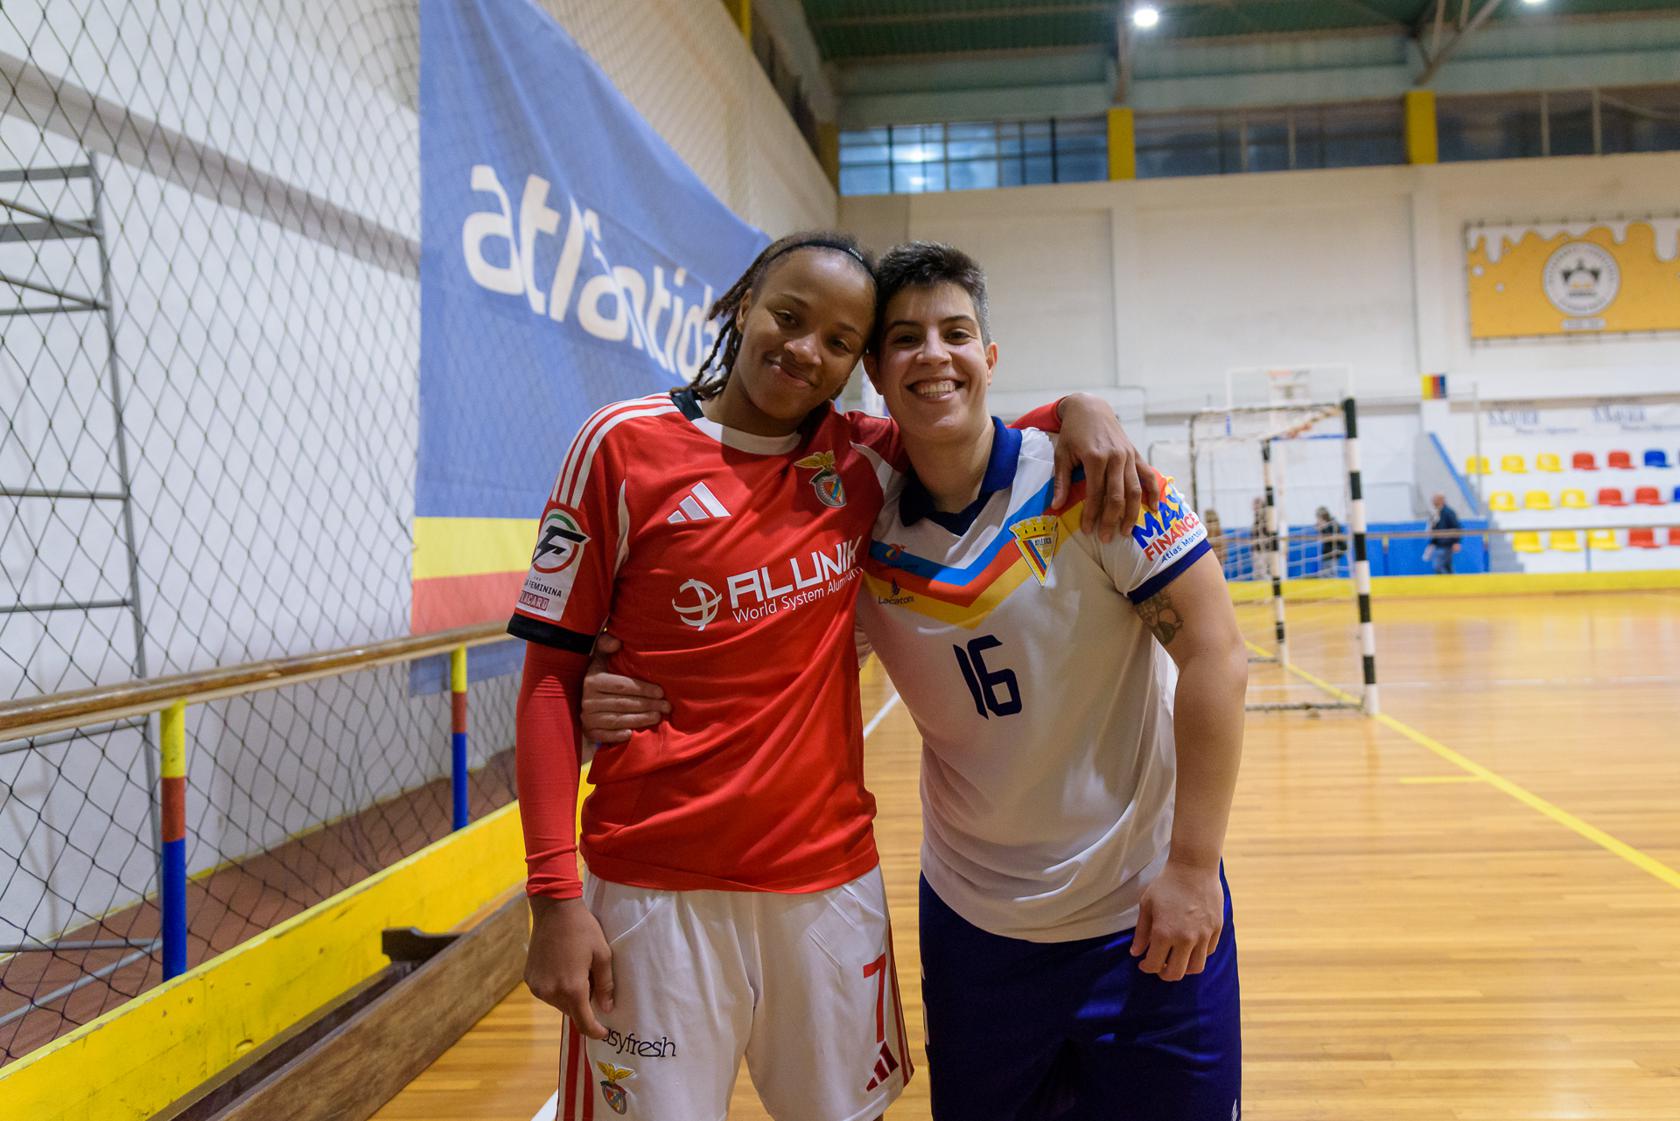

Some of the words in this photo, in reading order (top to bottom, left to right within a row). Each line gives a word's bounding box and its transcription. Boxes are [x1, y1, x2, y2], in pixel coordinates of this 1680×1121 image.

[726, 535, 863, 609] ALUNIK
[733, 598, 777, 624] World
[781, 587, 825, 611] System
[953, 634, 1022, 720] 16
[862, 952, 887, 1043] 7
